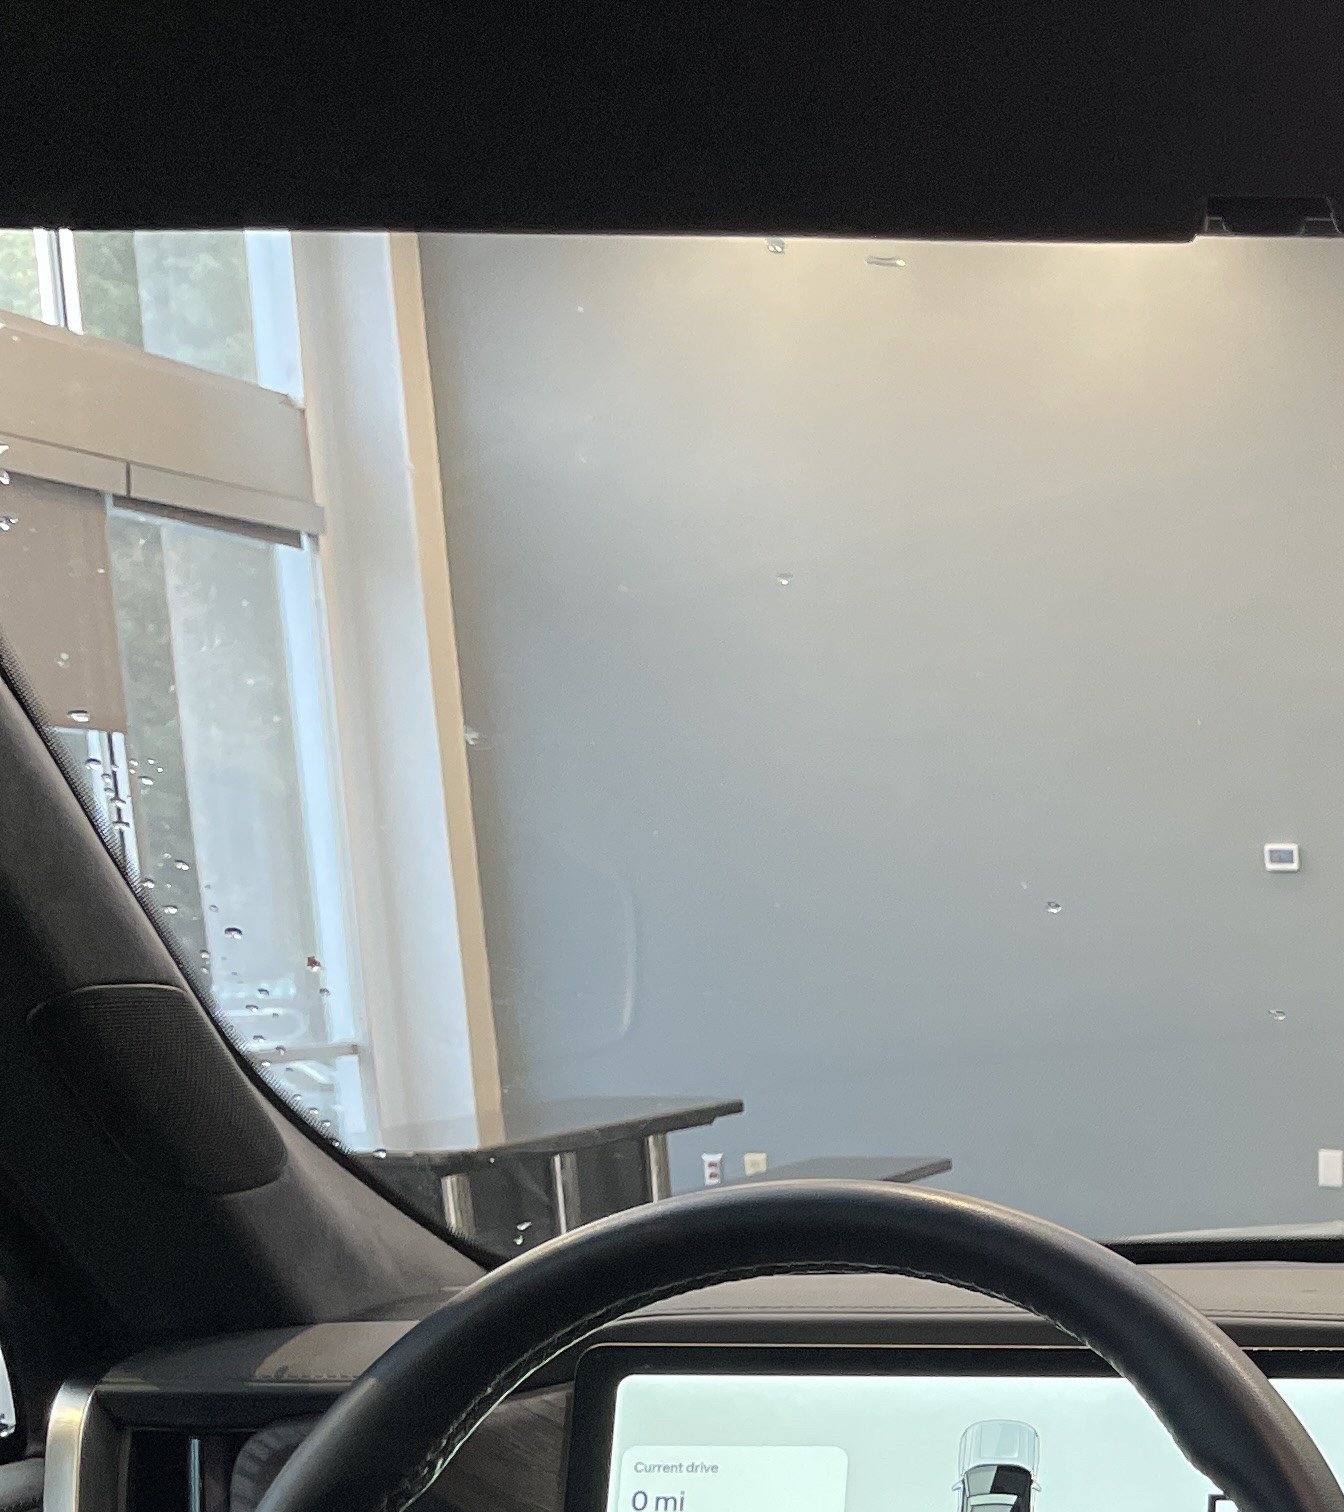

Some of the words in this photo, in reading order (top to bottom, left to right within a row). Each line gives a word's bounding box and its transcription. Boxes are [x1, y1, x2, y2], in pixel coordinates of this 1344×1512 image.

[634, 1461, 683, 1474] Current
[686, 1461, 719, 1474] drive
[632, 1490, 648, 1512] 0
[655, 1490, 685, 1512] mi
